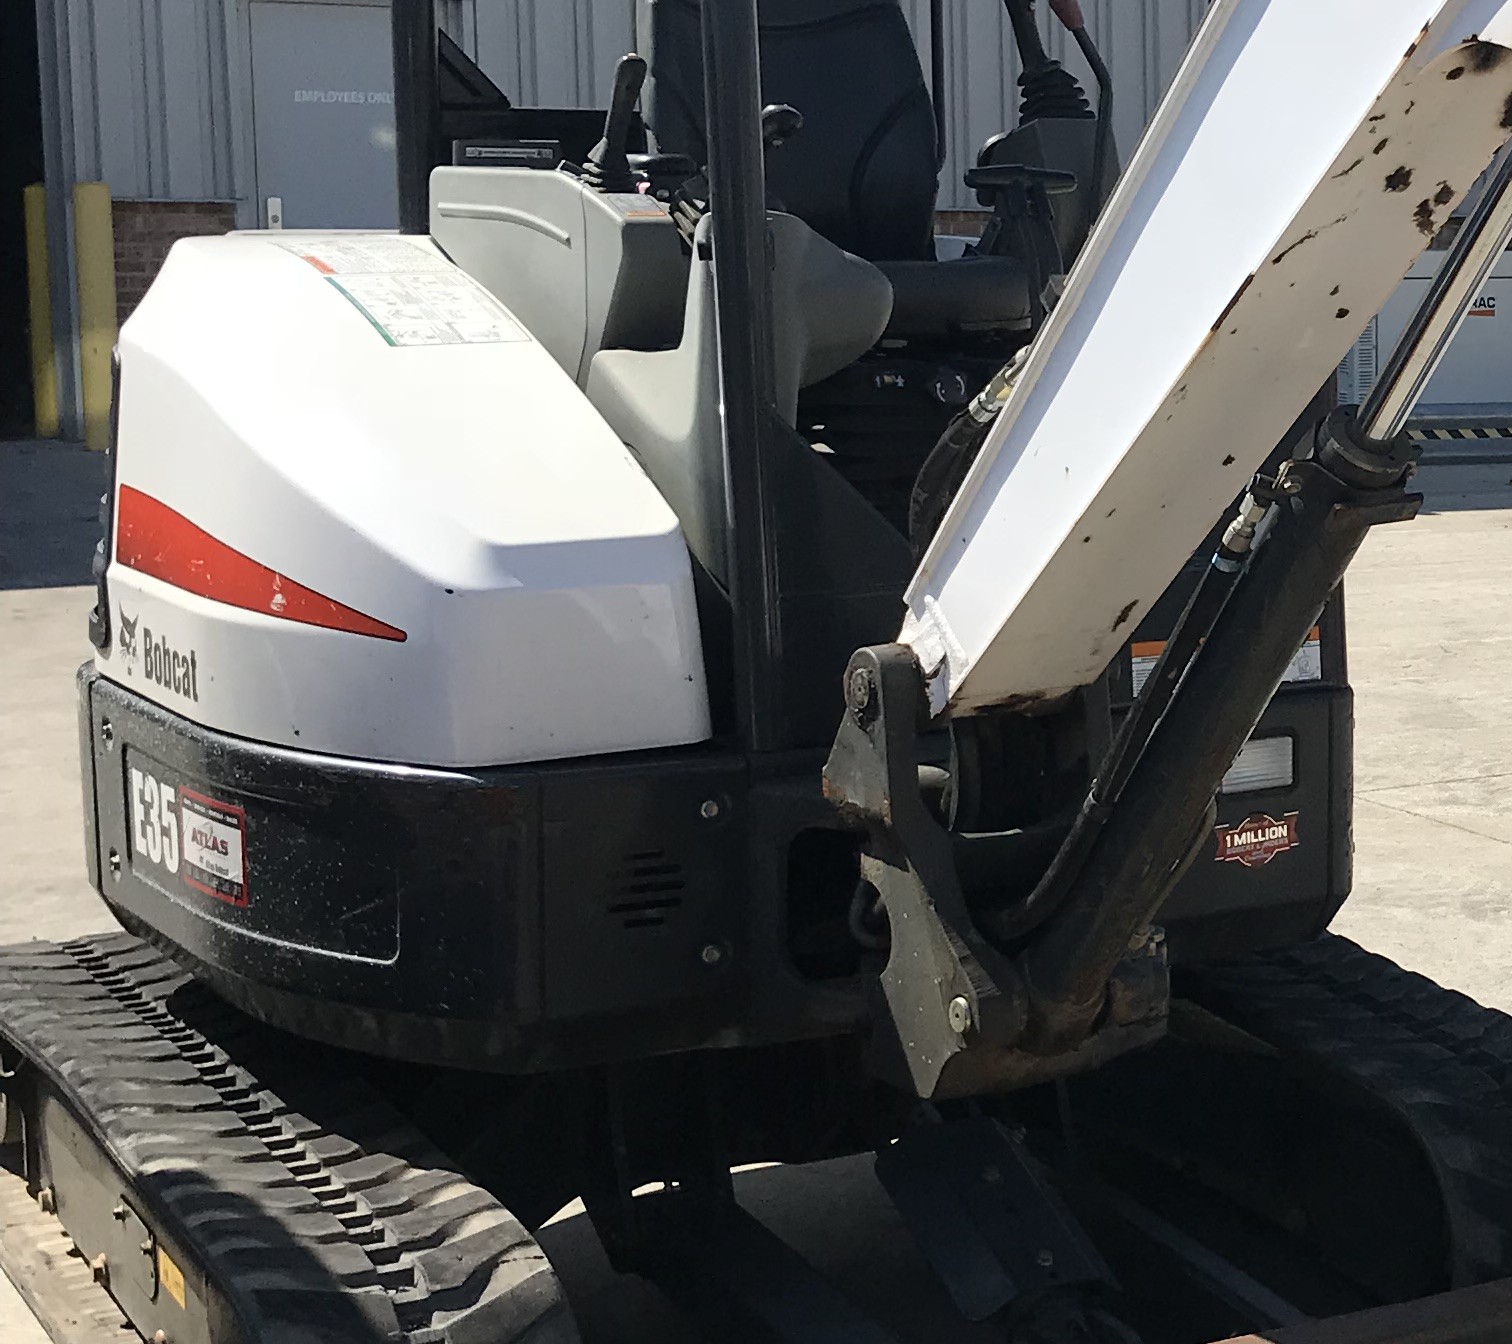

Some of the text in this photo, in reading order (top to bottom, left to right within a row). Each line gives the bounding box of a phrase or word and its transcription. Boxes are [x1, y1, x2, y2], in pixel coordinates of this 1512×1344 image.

[294, 89, 395, 105] EMPLOYEES ONL
[143, 626, 199, 703] Bobcat
[131, 767, 180, 874] E35
[191, 827, 229, 856] ATLAS
[1225, 834, 1232, 848] 1
[1233, 824, 1288, 847] MILLION
